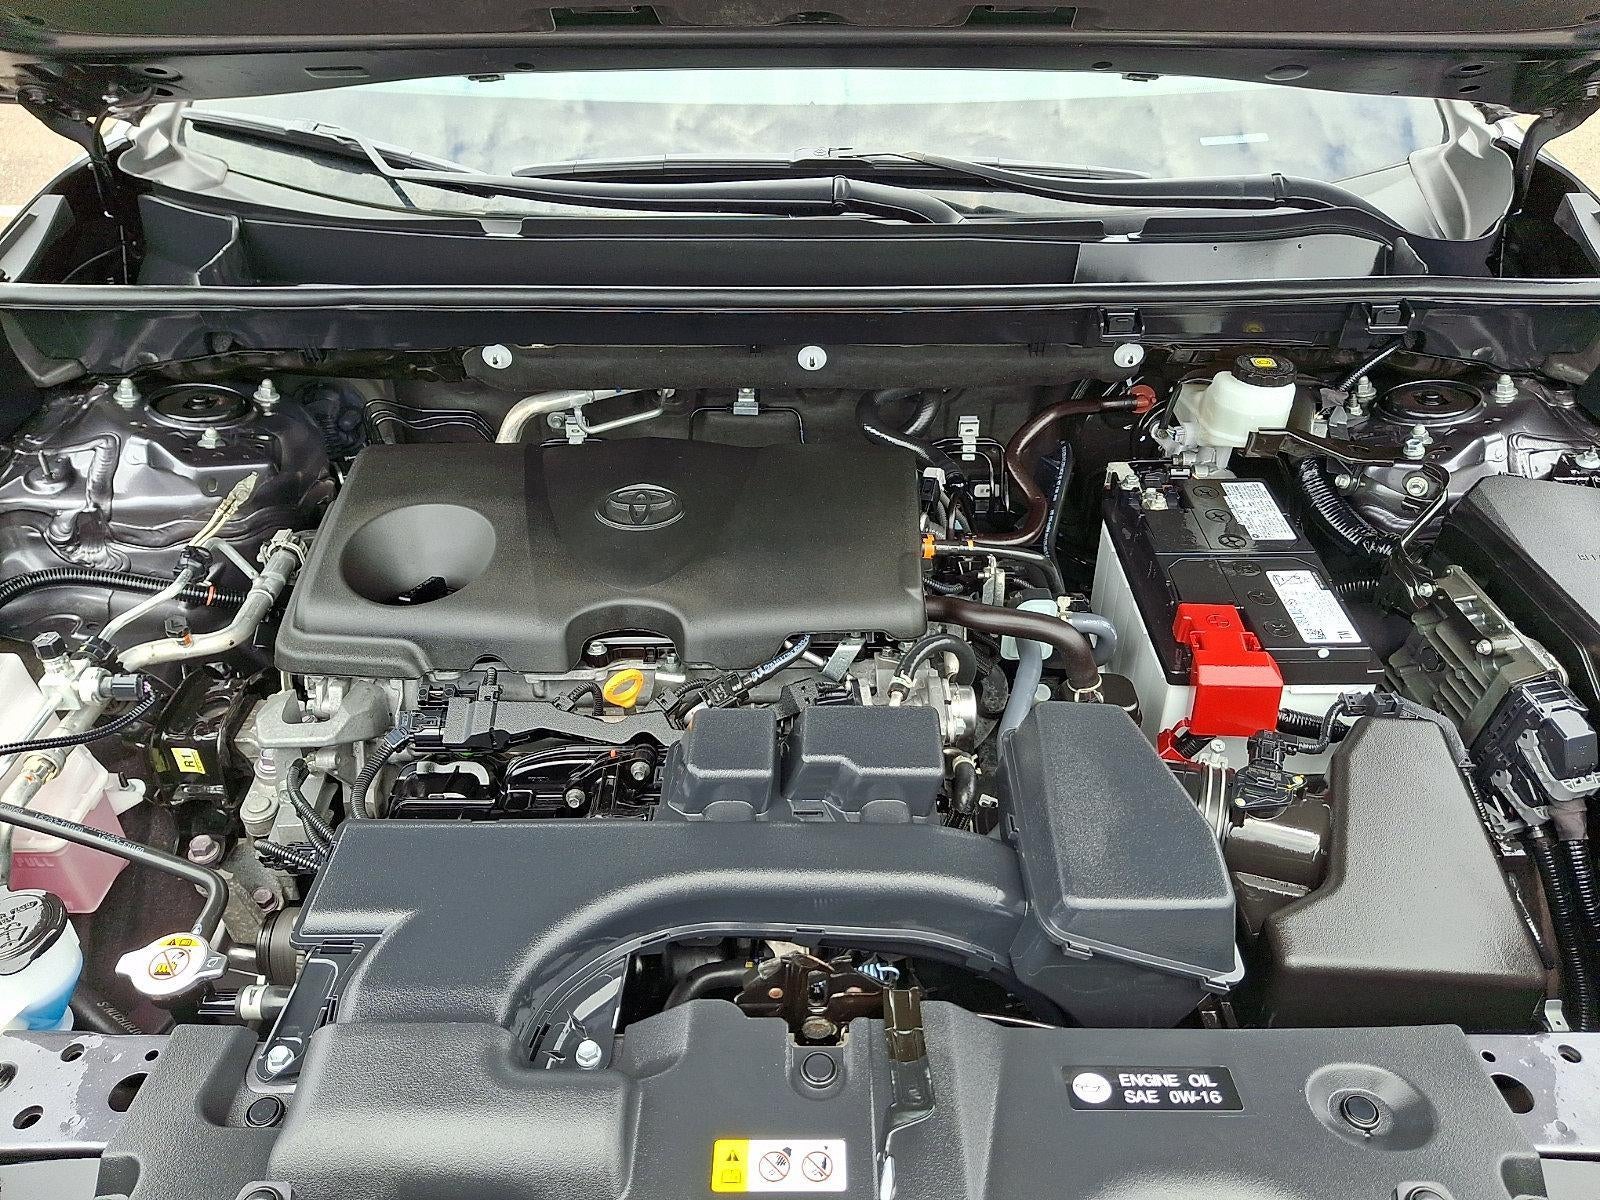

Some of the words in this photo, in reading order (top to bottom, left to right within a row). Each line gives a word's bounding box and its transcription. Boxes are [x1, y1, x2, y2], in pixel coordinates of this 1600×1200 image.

[181, 754, 195, 767] R1
[1118, 1073, 1181, 1087] ENGINE
[1188, 1073, 1218, 1088] OIL
[1123, 1090, 1160, 1104] SAE
[1169, 1090, 1223, 1104] 0W-16
